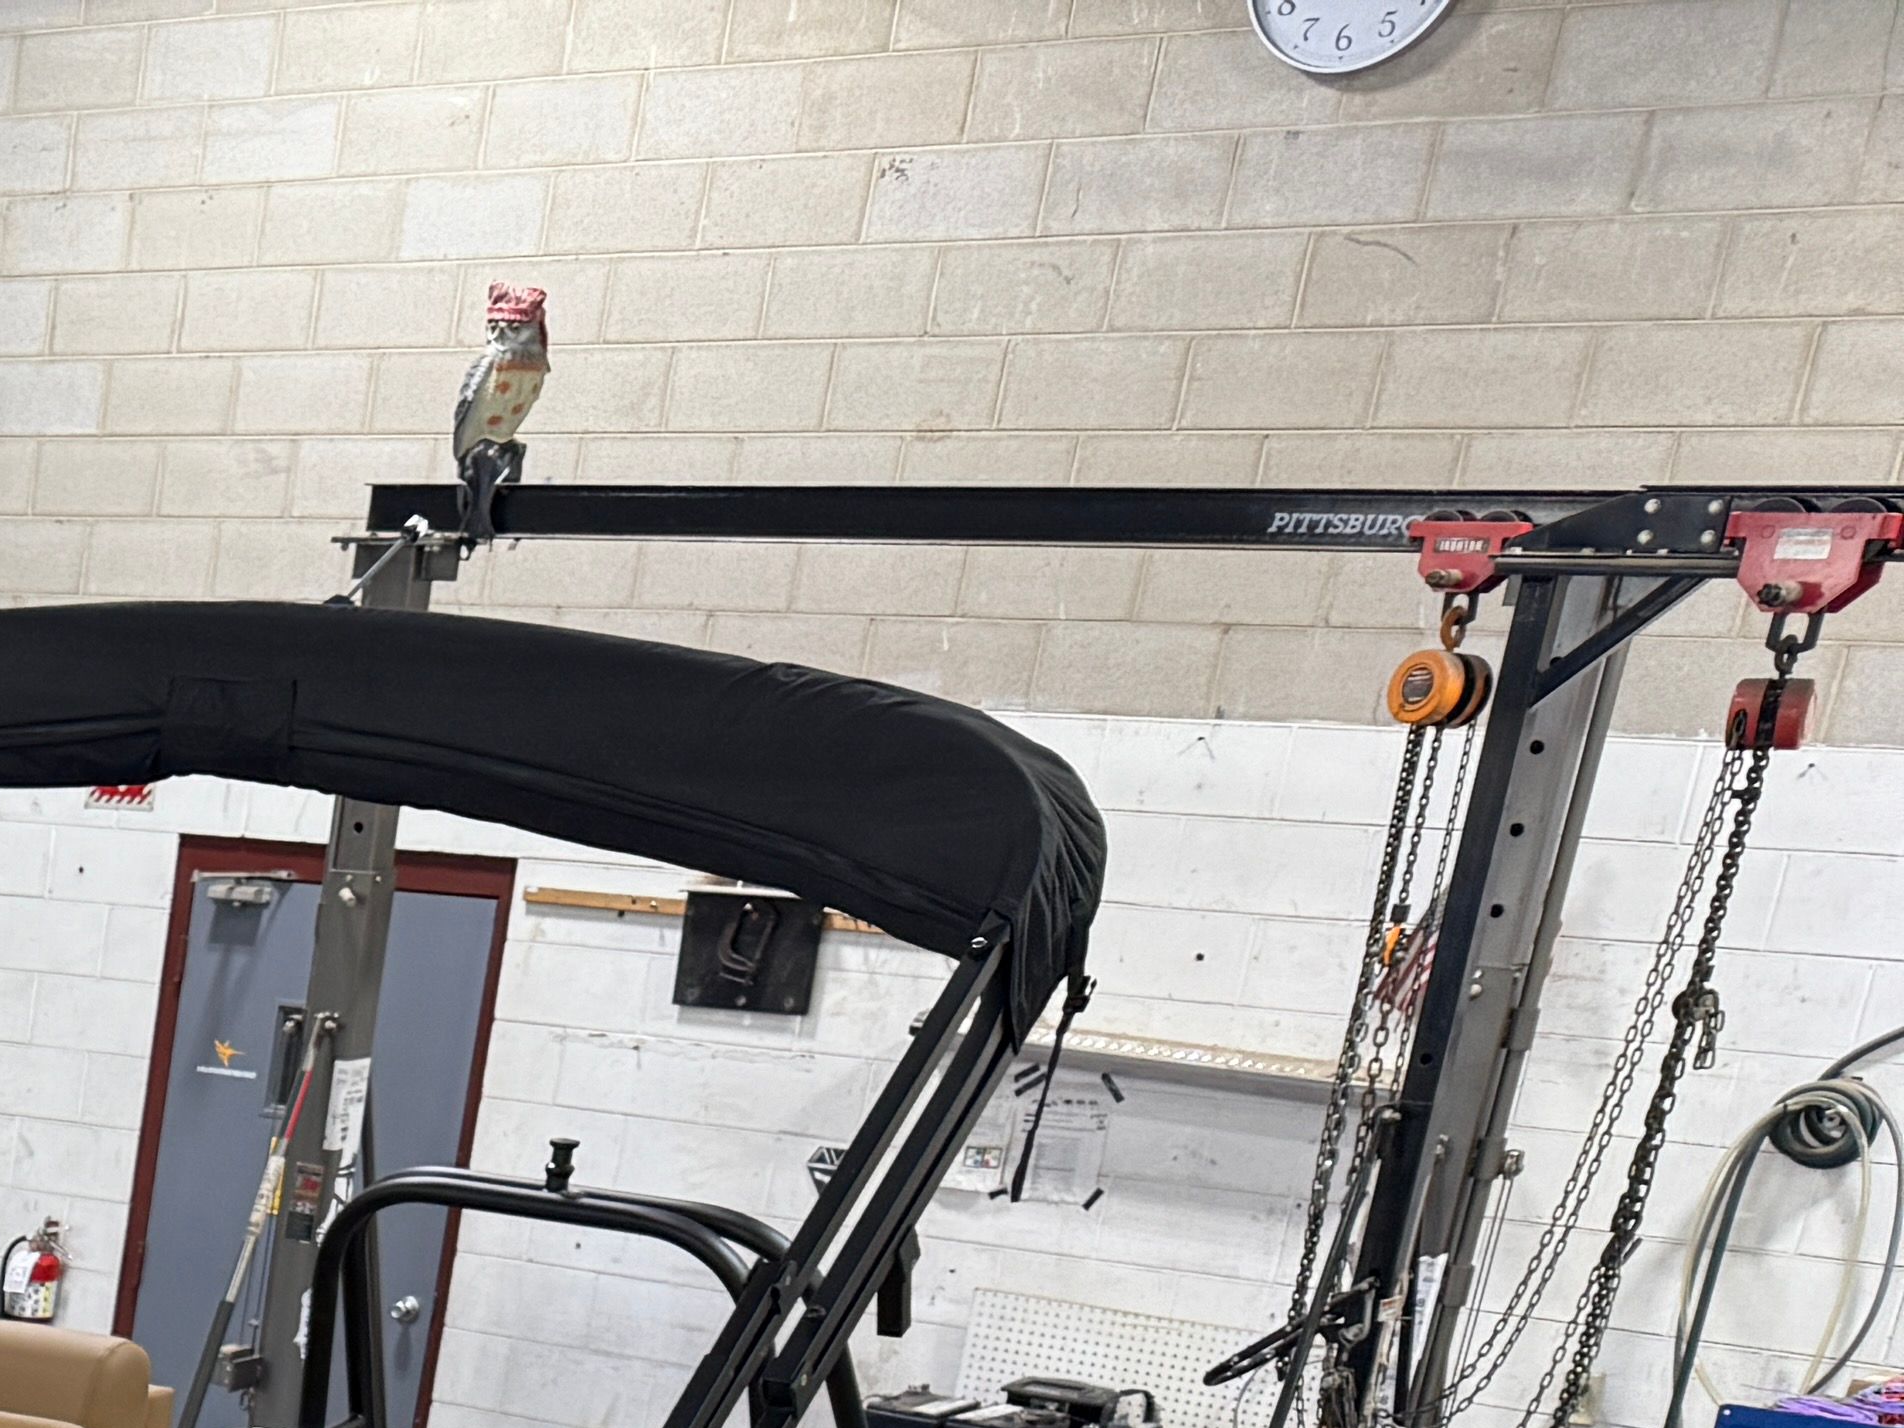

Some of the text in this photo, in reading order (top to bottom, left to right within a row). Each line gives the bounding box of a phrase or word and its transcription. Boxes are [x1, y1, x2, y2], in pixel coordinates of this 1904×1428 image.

[1303, 17, 1320, 42] 7
[1335, 23, 1353, 51] 6
[1378, 10, 1398, 38] 5
